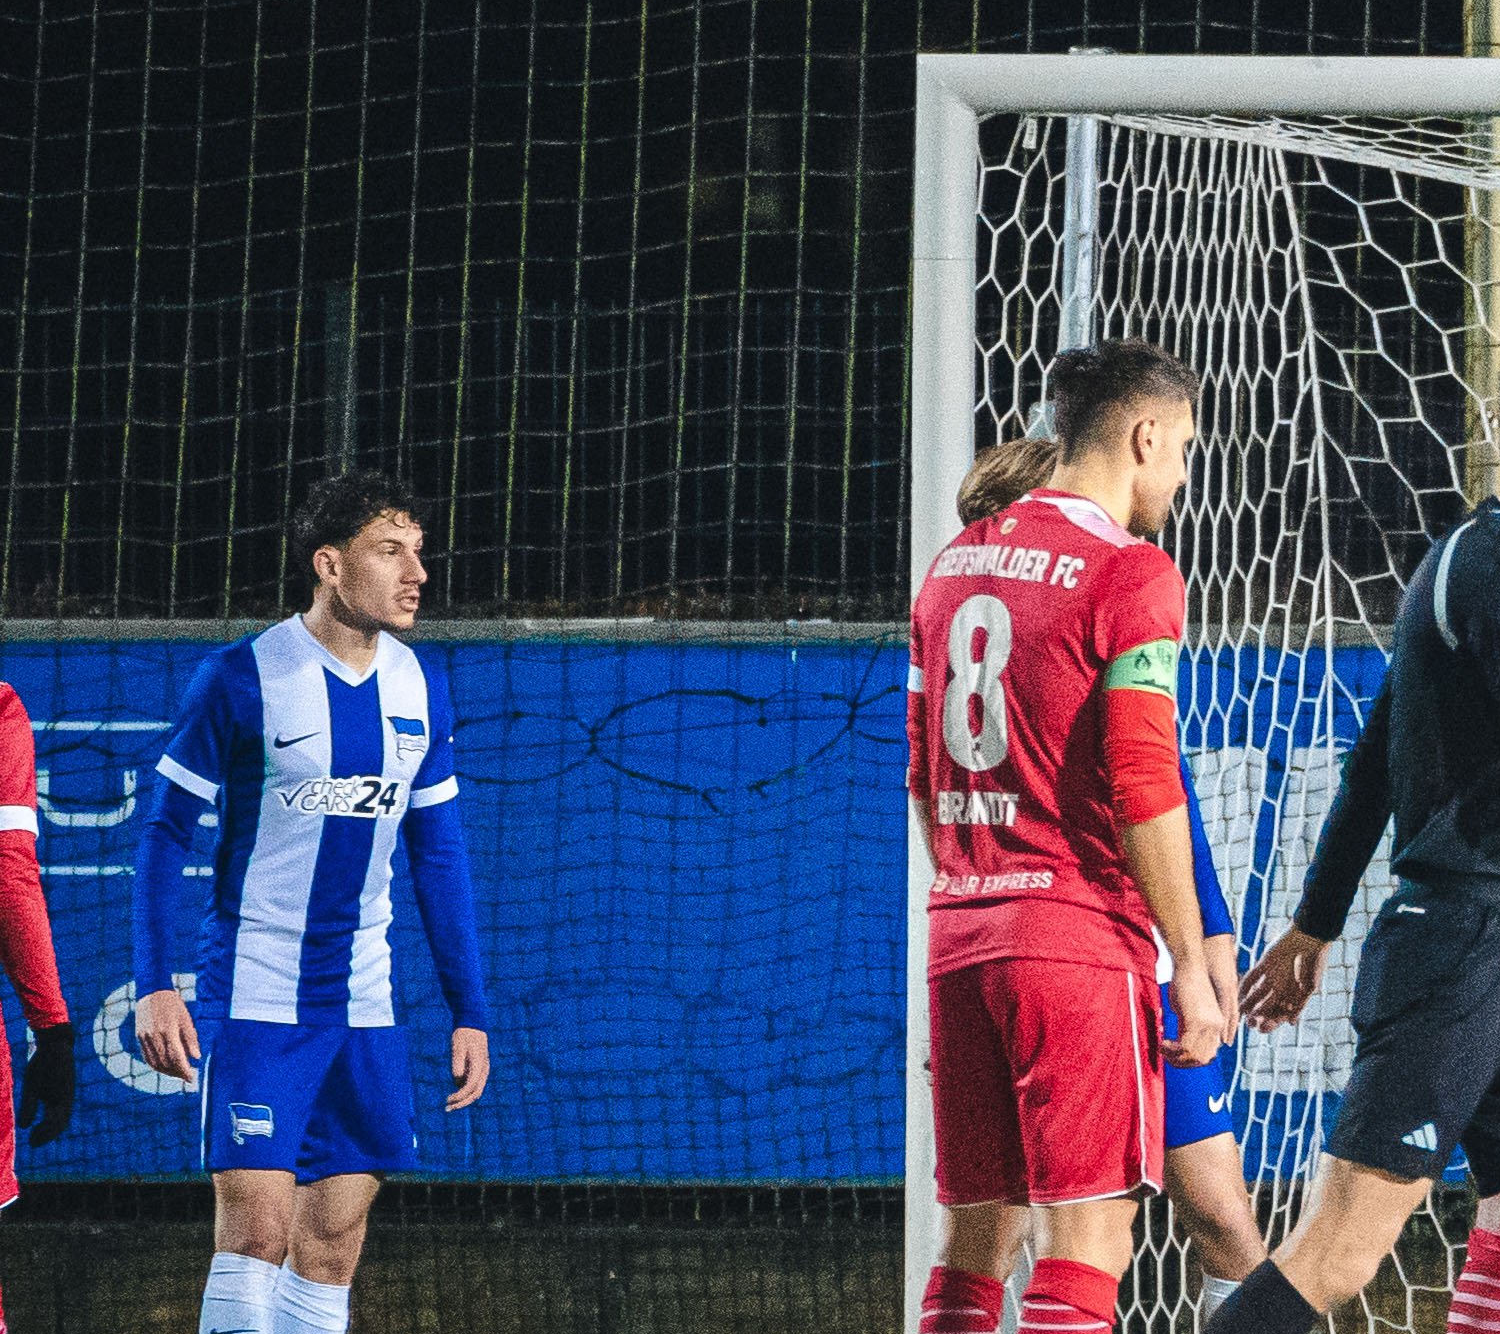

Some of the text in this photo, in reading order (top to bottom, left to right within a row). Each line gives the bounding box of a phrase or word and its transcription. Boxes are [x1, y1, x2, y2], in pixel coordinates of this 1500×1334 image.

[1050, 554, 1086, 589] FC
[942, 593, 1013, 772] 8
[980, 871, 1054, 895] EXPRESS
